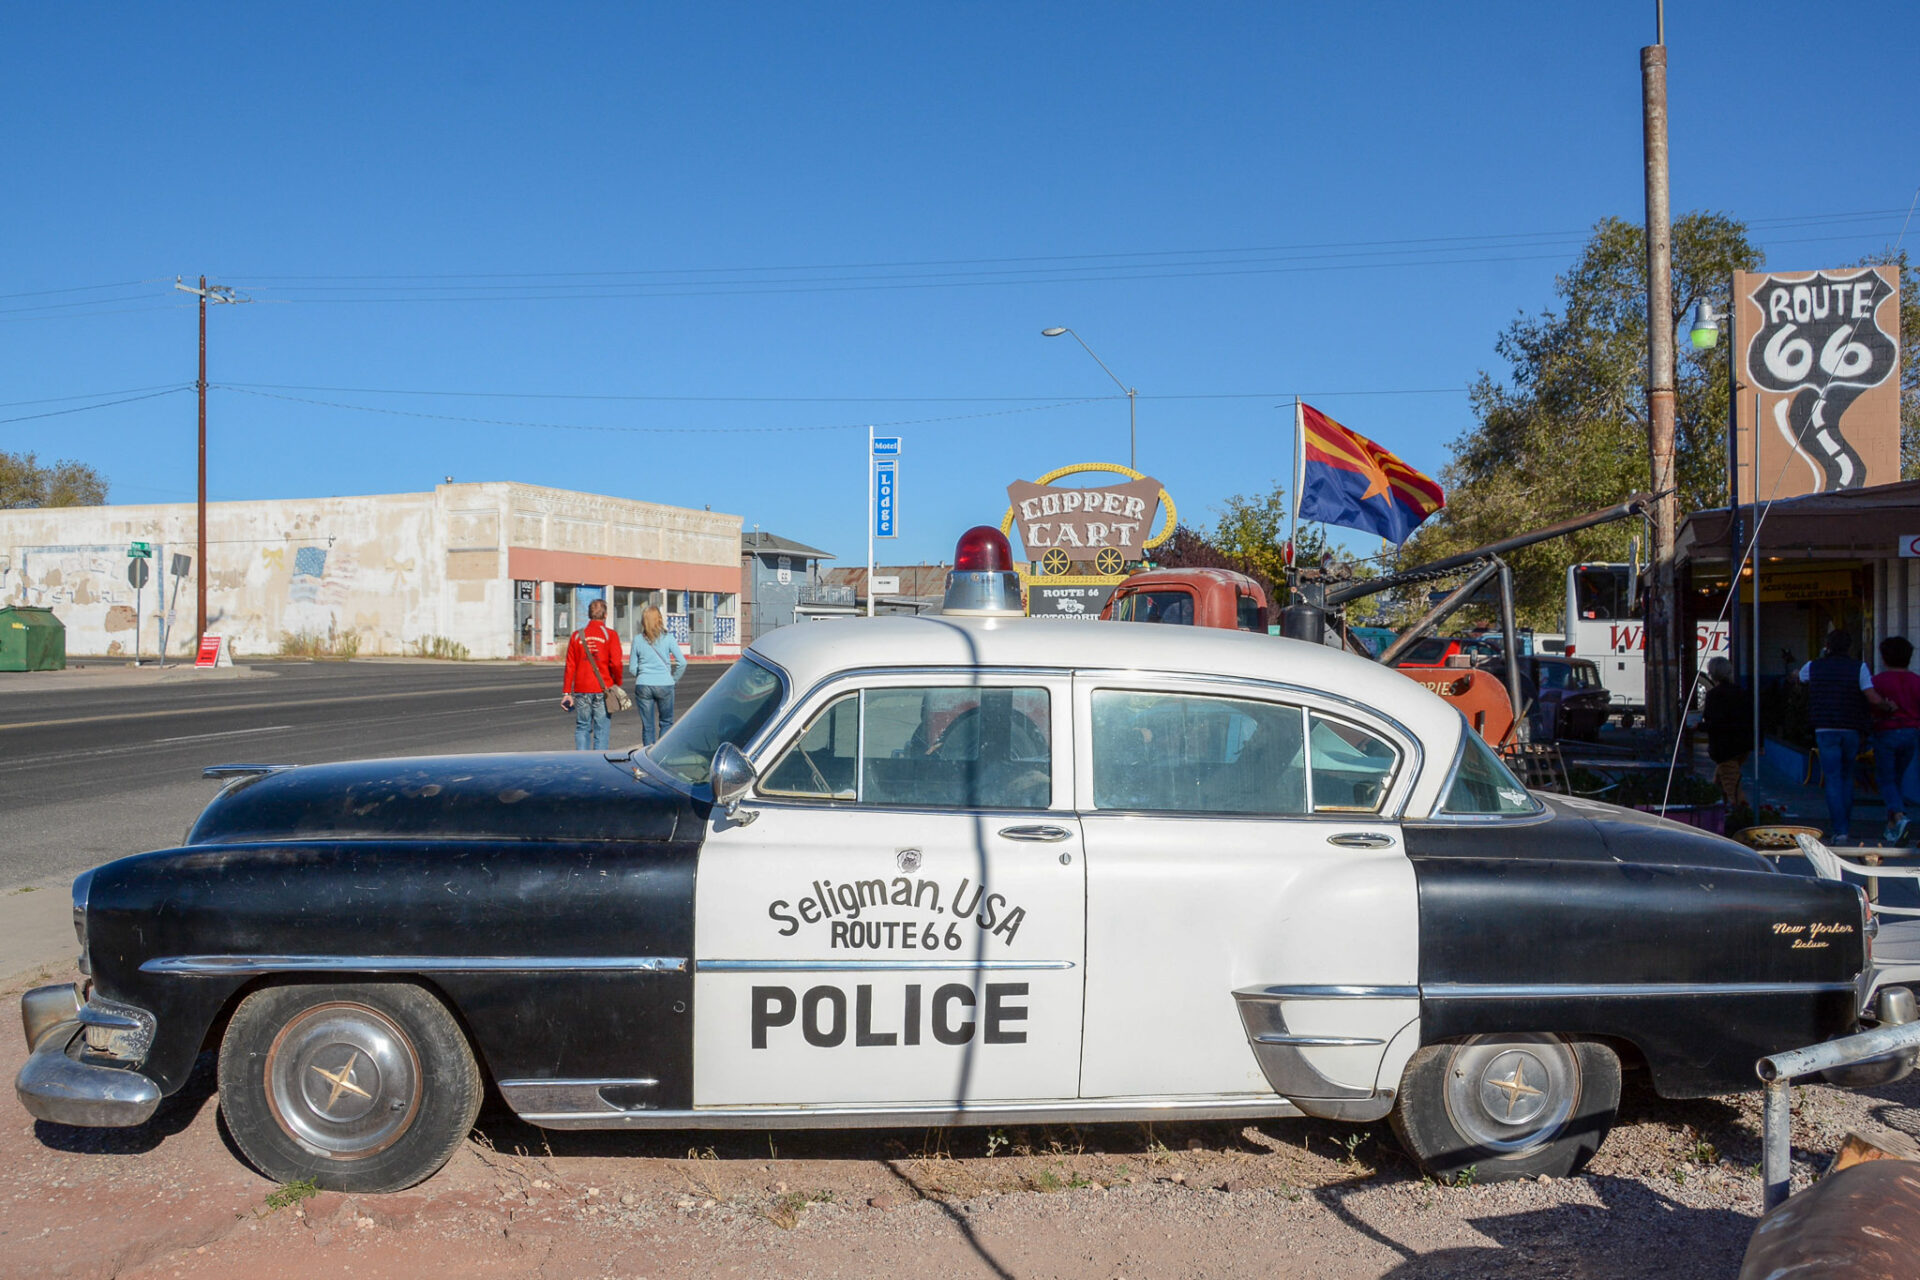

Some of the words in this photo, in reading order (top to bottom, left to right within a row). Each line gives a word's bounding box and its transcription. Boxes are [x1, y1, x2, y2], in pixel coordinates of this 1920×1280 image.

[1769, 281, 1874, 324] ROUTE
[1763, 323, 1873, 382] 66
[874, 442, 897, 450] Motel
[880, 474, 891, 531] Lodge
[1018, 491, 1146, 521] COPPER
[1026, 521, 1140, 548] CART
[1042, 589, 1085, 598] ROUTE
[1088, 588, 1099, 597] 66
[768, 876, 944, 937] Seligman,
[951, 877, 1027, 946] USA
[830, 920, 917, 949] ROUTE
[921, 921, 962, 951] 66
[1772, 922, 1806, 935] New
[1809, 922, 1854, 939] Yorker
[1791, 938, 1830, 949] Deluxe
[751, 982, 1029, 1049] POLICE
